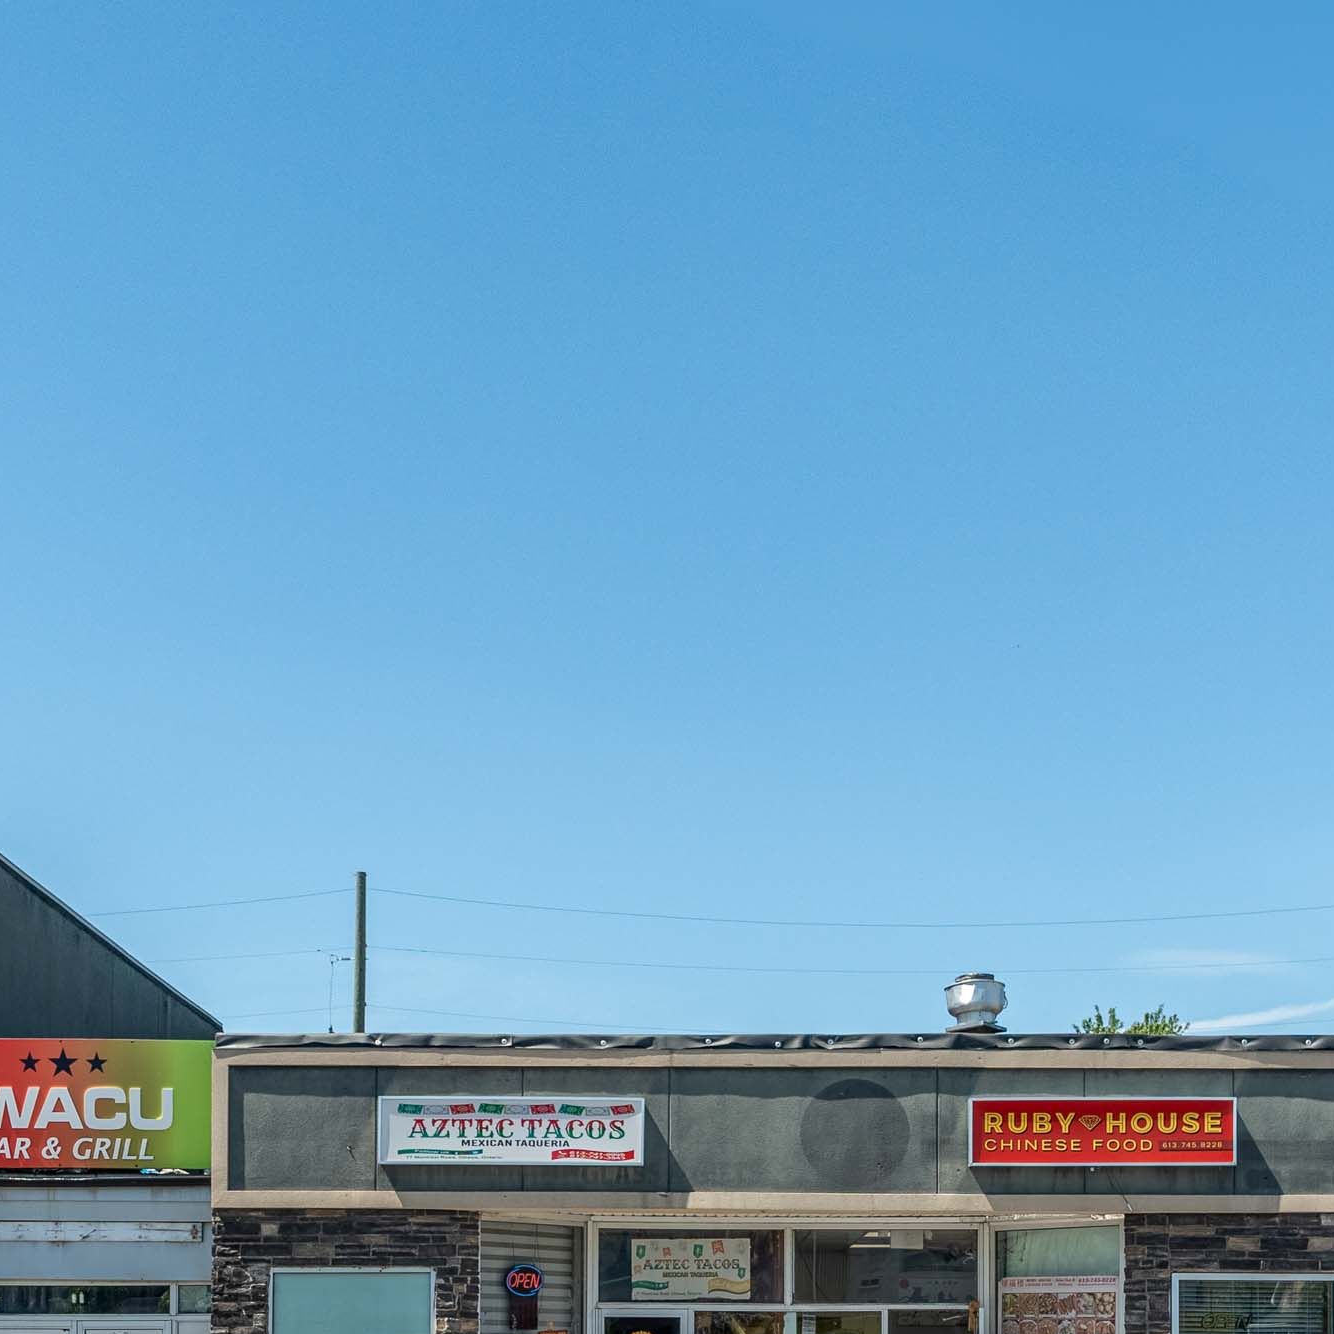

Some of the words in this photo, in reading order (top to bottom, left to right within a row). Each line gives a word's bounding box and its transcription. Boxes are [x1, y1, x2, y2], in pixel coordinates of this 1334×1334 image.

[407, 1118, 515, 1139] AZTEC
[520, 1118, 626, 1140] TACOS
[983, 1111, 1076, 1134] RUBY
[1106, 1111, 1223, 1134] HOUSE
[41, 1136, 62, 1161] &
[72, 1137, 155, 1161] GRILL
[461, 1139, 513, 1147] MEXICAN
[515, 1139, 570, 1148] TAQUERIA
[983, 1138, 1082, 1151] CHINESE
[1092, 1138, 1153, 1151] FOOD
[643, 1258, 690, 1270] AZTEC
[694, 1258, 740, 1270] TACOS
[508, 1273, 540, 1288] OPEN
